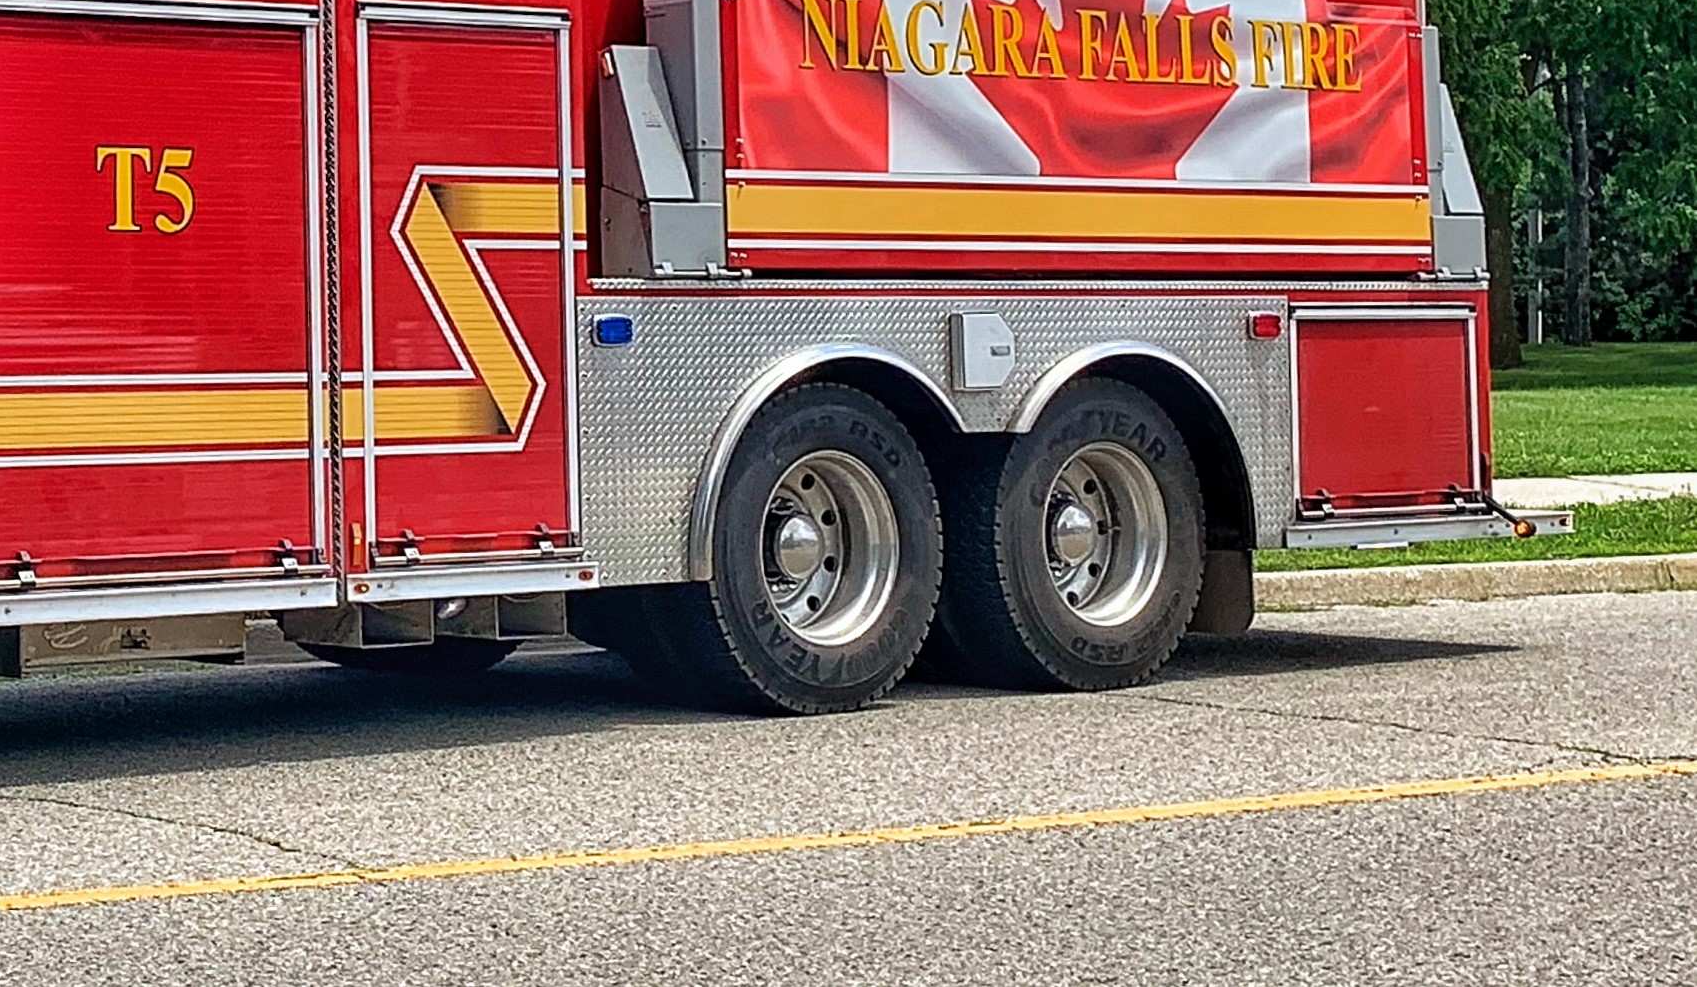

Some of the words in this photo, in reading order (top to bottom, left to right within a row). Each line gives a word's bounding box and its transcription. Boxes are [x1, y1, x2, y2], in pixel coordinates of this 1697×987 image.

[1075, 8, 1238, 87] FALLS
[1247, 19, 1363, 92] FIRE
[94, 144, 196, 234] T5
[849, 419, 901, 468] RSD
[753, 598, 910, 685] GOODYEAR
